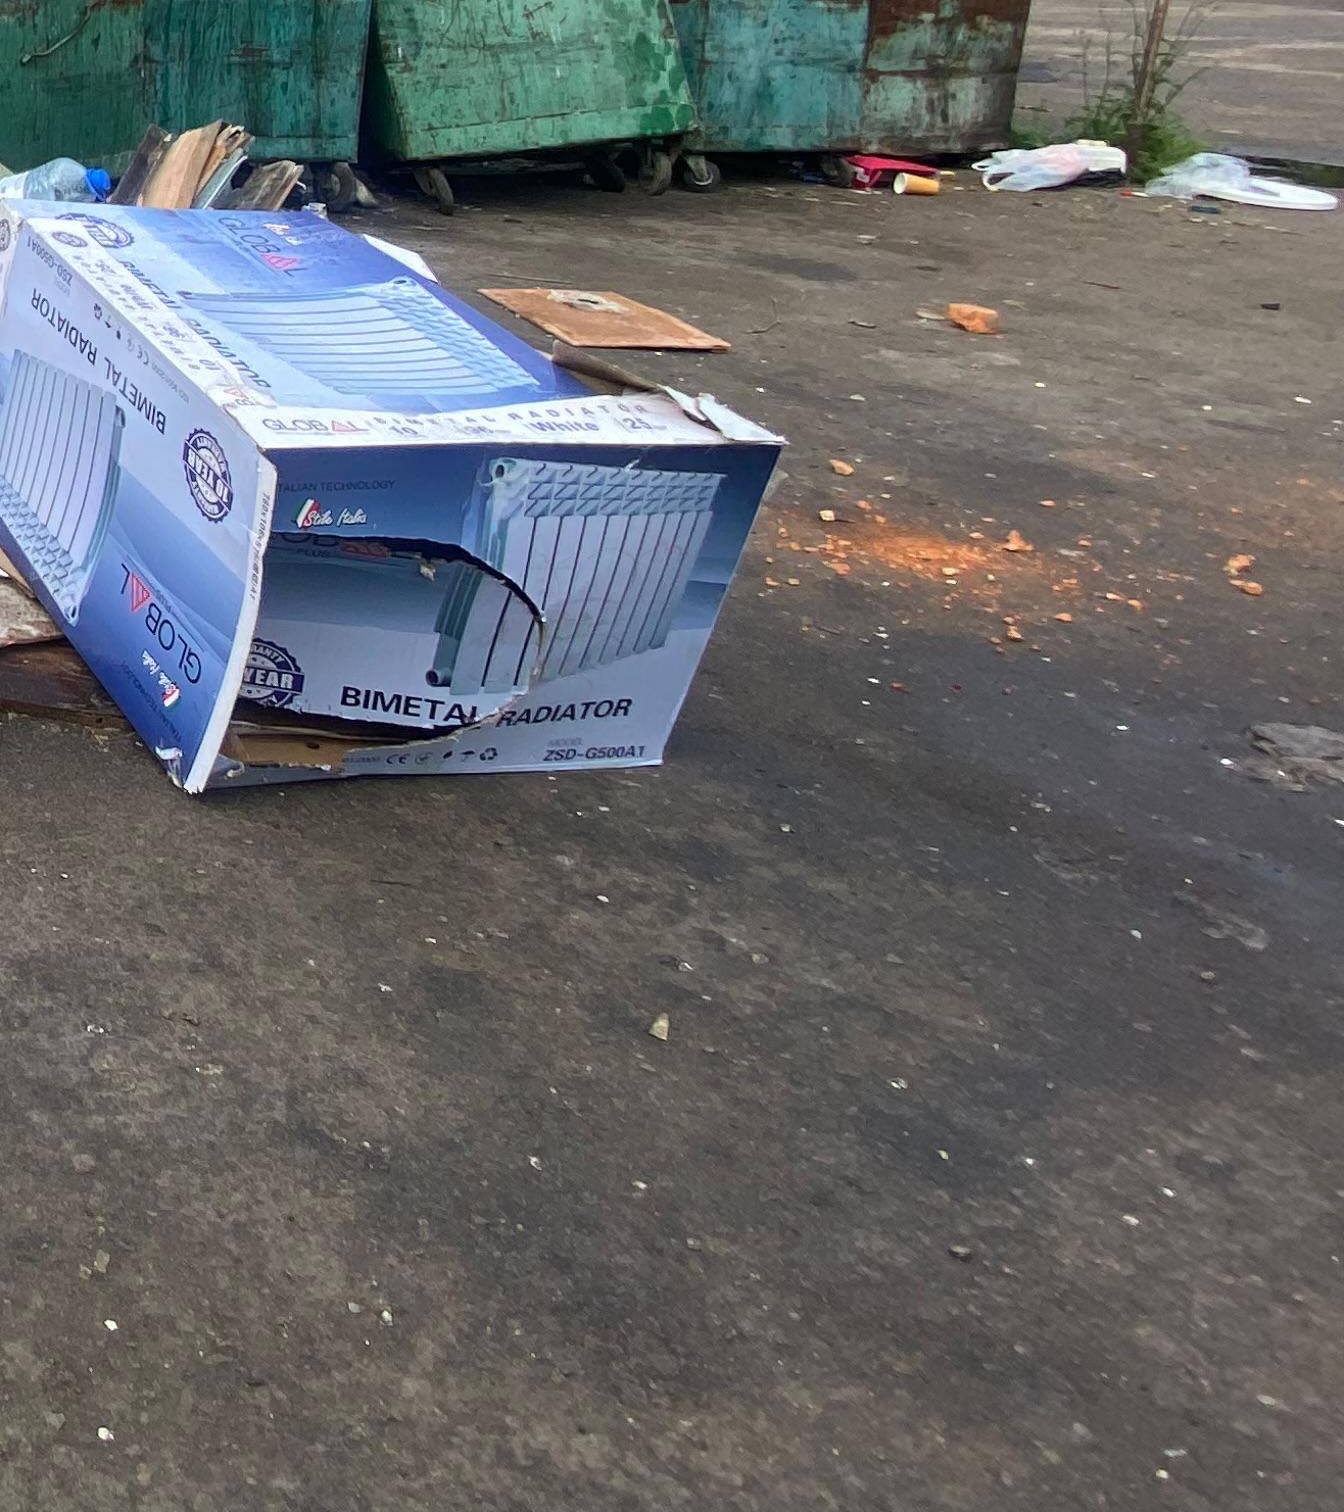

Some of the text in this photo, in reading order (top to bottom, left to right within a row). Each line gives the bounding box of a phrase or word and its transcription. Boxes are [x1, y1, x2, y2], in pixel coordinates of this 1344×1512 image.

[30, 287, 99, 366] RADIATOR
[103, 355, 167, 436] BIMETAL
[534, 419, 600, 433] White
[320, 480, 396, 492] TECHNOLOGY
[119, 563, 202, 685] GLOBAL
[339, 685, 633, 729] BIMETAL RADIATOR
[542, 745, 647, 762] ZSD-G500A1
